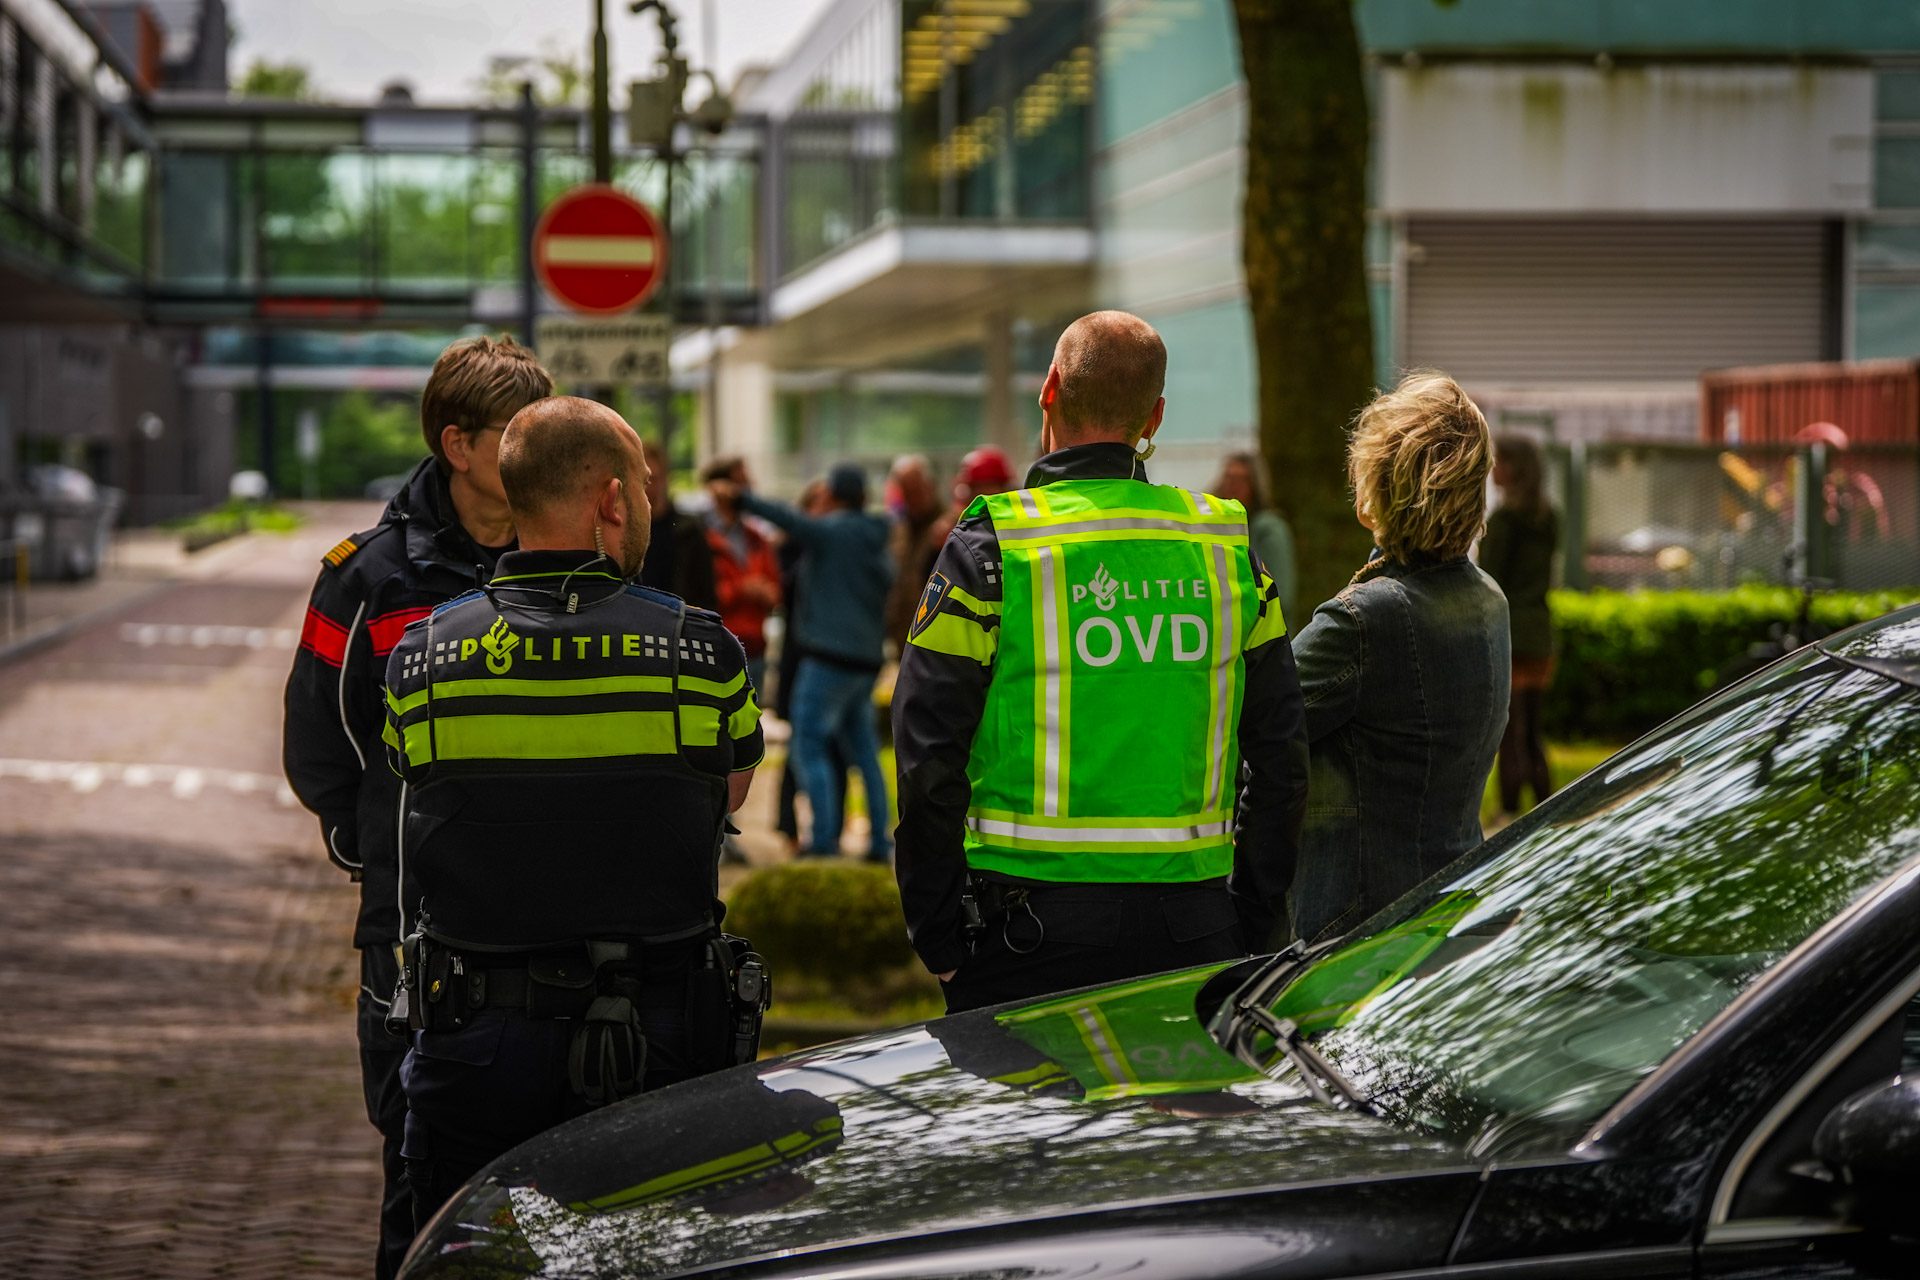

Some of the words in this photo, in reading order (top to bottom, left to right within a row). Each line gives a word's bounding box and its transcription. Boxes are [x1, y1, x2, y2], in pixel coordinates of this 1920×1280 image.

[1072, 578, 1207, 611] POLITIE
[460, 634, 641, 675] POLITIE
[1075, 614, 1209, 667] OVD
